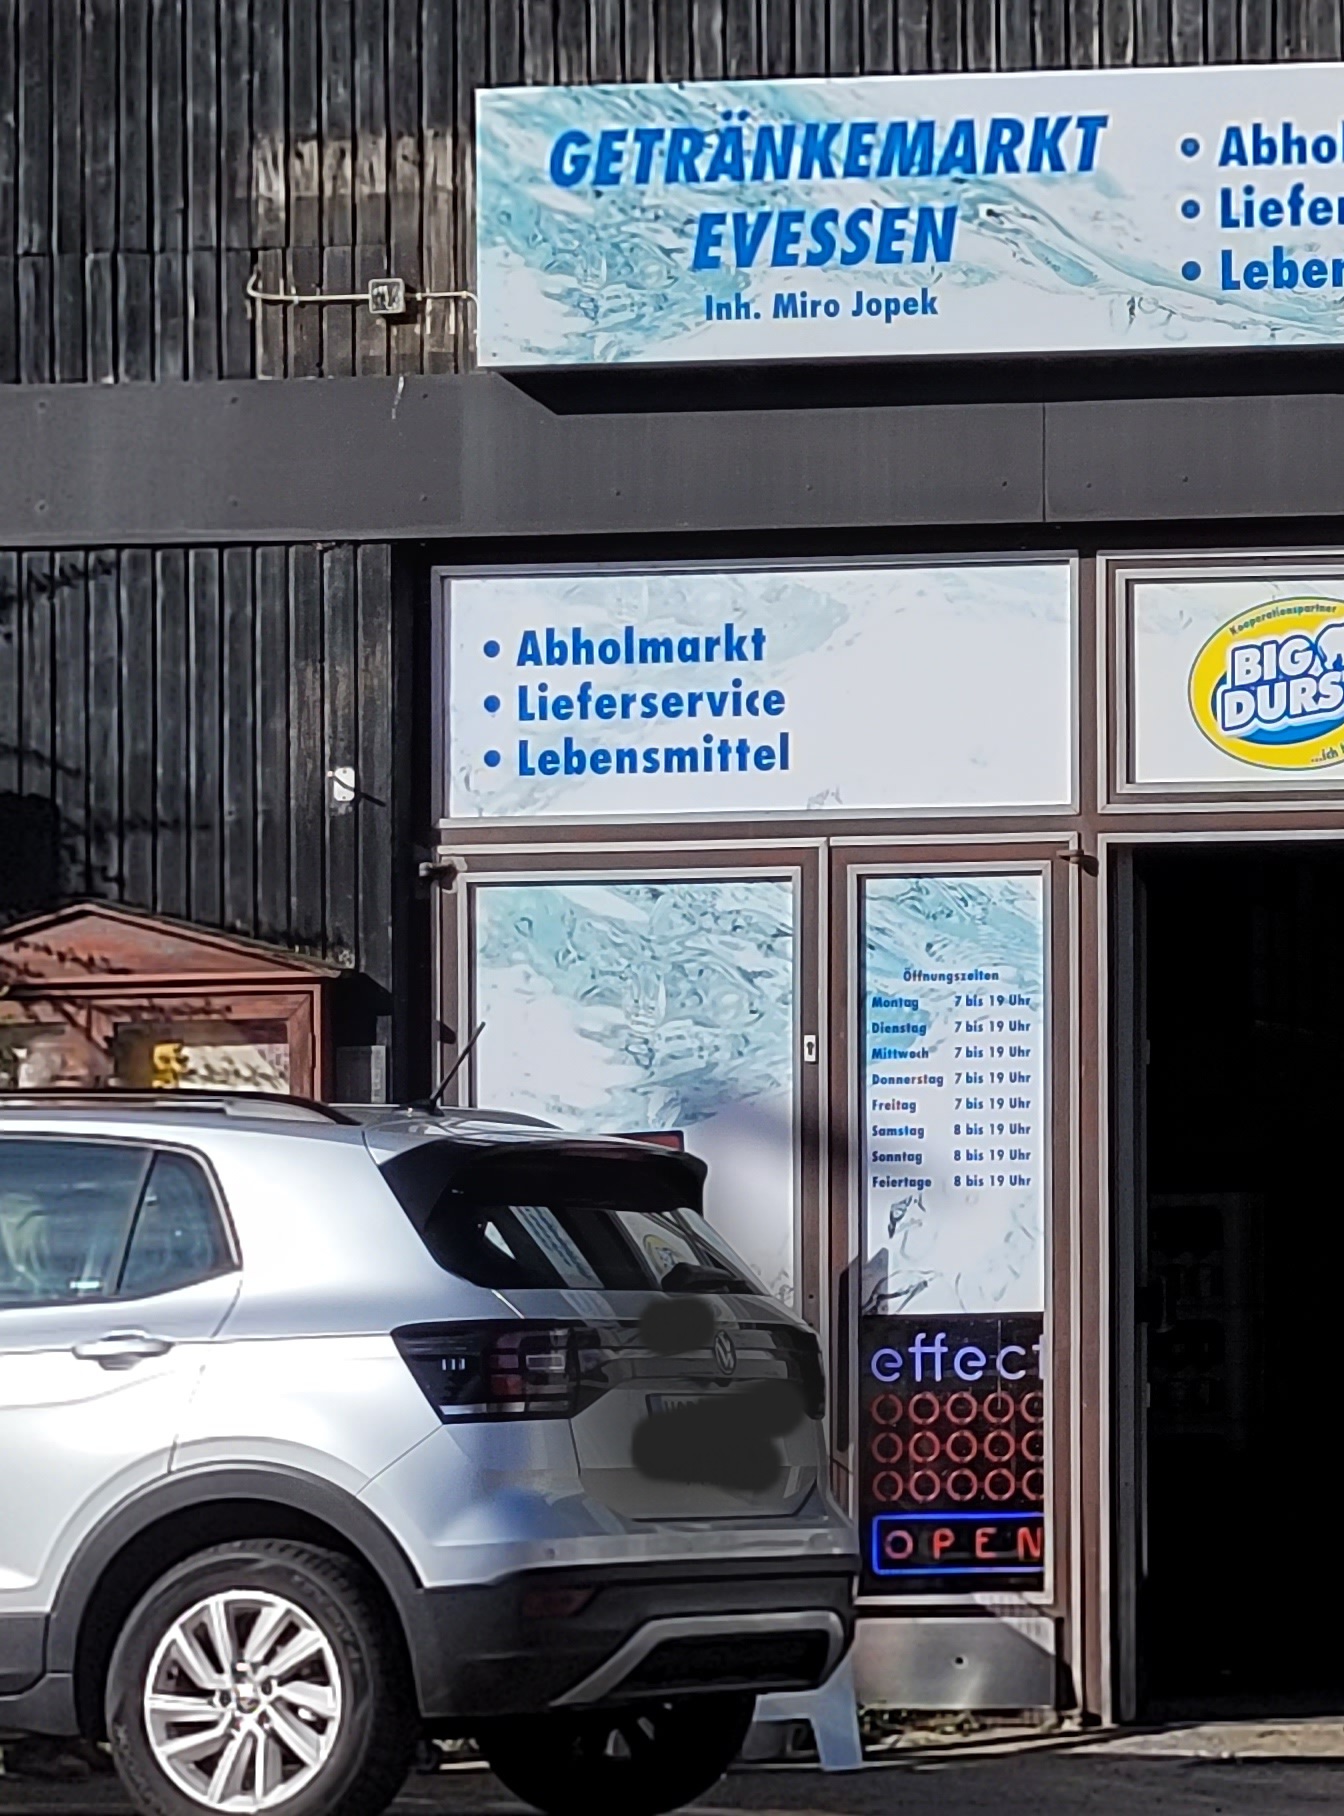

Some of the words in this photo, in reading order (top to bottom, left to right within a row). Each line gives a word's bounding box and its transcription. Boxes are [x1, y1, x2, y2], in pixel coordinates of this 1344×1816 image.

[549, 110, 1108, 188] GETRÄNKEMARKT
[689, 203, 958, 271] EVESSEN
[705, 293, 760, 321] Inh.
[773, 291, 839, 318] Miro
[852, 288, 937, 323] Jopek
[1229, 603, 1338, 637] Kooperationspartner
[517, 623, 766, 666] Abholmarkt
[1233, 636, 1314, 686] BIG
[518, 678, 786, 721] Lieferservice
[518, 732, 790, 776] Lebensmittel
[902, 967, 1000, 985] Öffnungszeiten
[871, 996, 919, 1012] Montag
[954, 995, 962, 1007] 7
[965, 993, 984, 1007] bis
[989, 994, 1005, 1007] 19
[1008, 993, 1031, 1006] Uhr
[871, 1021, 927, 1037] Dienstag
[954, 1020, 962, 1033] 7
[965, 1019, 984, 1033] bis
[989, 1020, 1005, 1033] 19
[1008, 1019, 1031, 1032] Uhr
[871, 1046, 929, 1060] Mittwoch
[954, 1046, 962, 1059] 7
[965, 1045, 984, 1058] bis
[989, 1046, 1005, 1058] 19
[1008, 1045, 1031, 1058] Uhr
[872, 1073, 944, 1088] Donnerstag
[954, 1072, 962, 1084] 7
[965, 1071, 984, 1084] bis
[989, 1071, 1005, 1084] 19
[1008, 1071, 1031, 1084] Uhr
[872, 1098, 917, 1114] Freitag
[954, 1098, 962, 1110] 7
[965, 1097, 984, 1110] bis
[989, 1097, 1005, 1109] 19
[1008, 1097, 1031, 1109] Uhr
[871, 1124, 925, 1140] Samstag
[953, 1123, 962, 1136] 8
[965, 1123, 984, 1136] bis
[989, 1123, 1005, 1135] 19
[1008, 1122, 1031, 1135] Uhr
[871, 1150, 923, 1166] Sonntag
[953, 1149, 962, 1162] 8
[965, 1149, 984, 1162] bis
[989, 1149, 1005, 1161] 19
[1008, 1148, 1031, 1161] Uhr
[872, 1174, 932, 1191] Feiertage
[953, 1175, 962, 1187] 8
[965, 1174, 984, 1187] bis
[989, 1175, 1005, 1187] 19
[1008, 1174, 1031, 1187] Uhr
[883, 1526, 1044, 1561] OPEN
